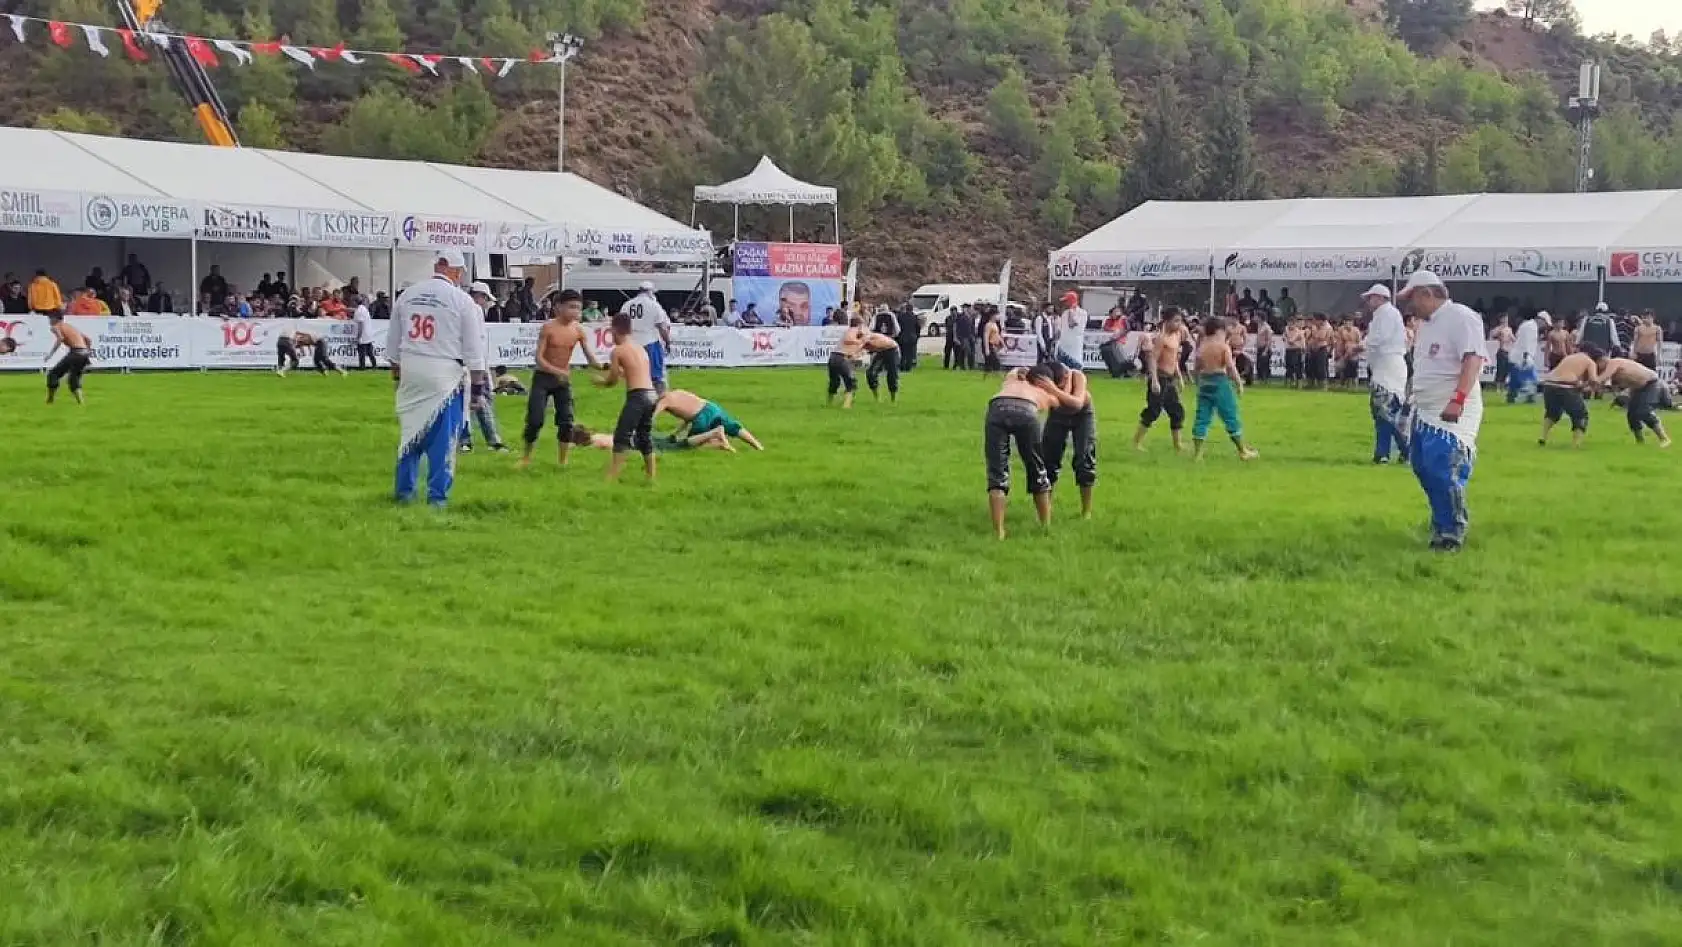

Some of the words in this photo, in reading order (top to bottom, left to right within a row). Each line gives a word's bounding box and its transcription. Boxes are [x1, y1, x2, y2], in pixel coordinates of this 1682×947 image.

[121, 203, 189, 220] BAVYERA
[142, 219, 170, 233] PUB
[324, 211, 389, 236] KÖRFEZ
[608, 243, 637, 255] HOTEL
[1425, 264, 1489, 277] SEMAVER
[629, 303, 643, 319] 60
[408, 314, 435, 341] 36
[88, 346, 115, 360] ağlı
